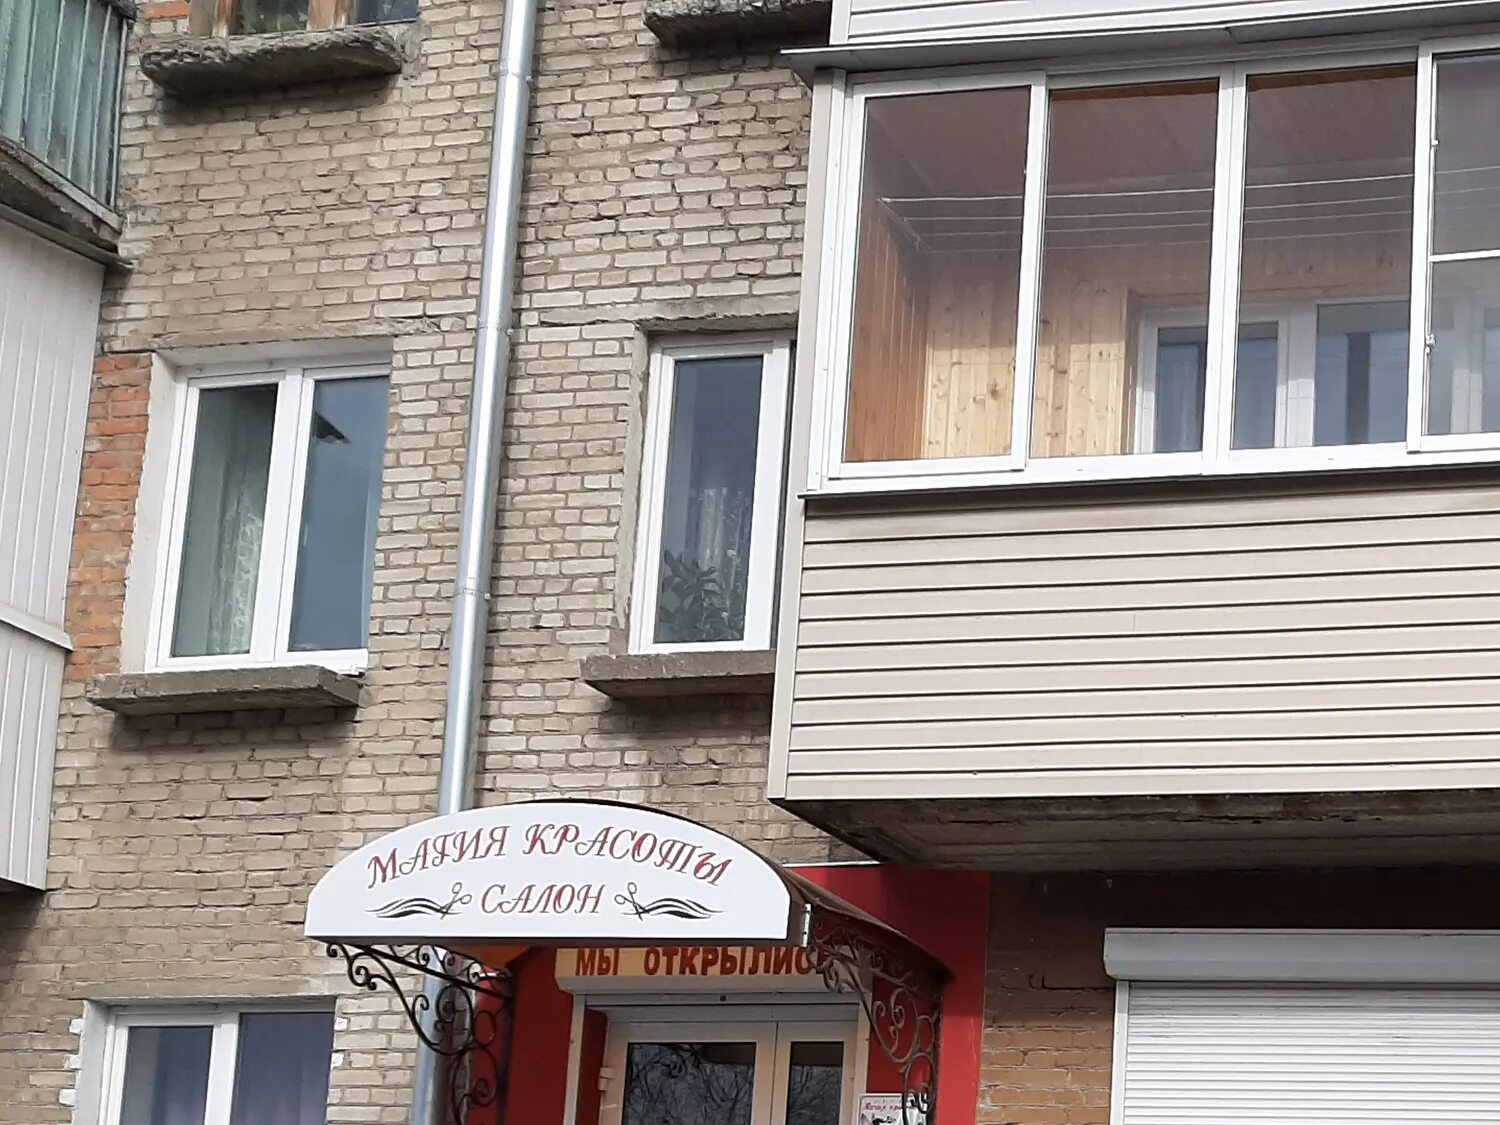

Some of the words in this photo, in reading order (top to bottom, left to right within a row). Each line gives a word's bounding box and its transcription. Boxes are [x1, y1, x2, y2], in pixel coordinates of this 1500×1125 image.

[366, 825, 509, 890] МАГИЯ
[522, 823, 734, 887] КРАСОТЫ
[480, 882, 606, 916] САЛОН
[575, 947, 620, 976] МЫ
